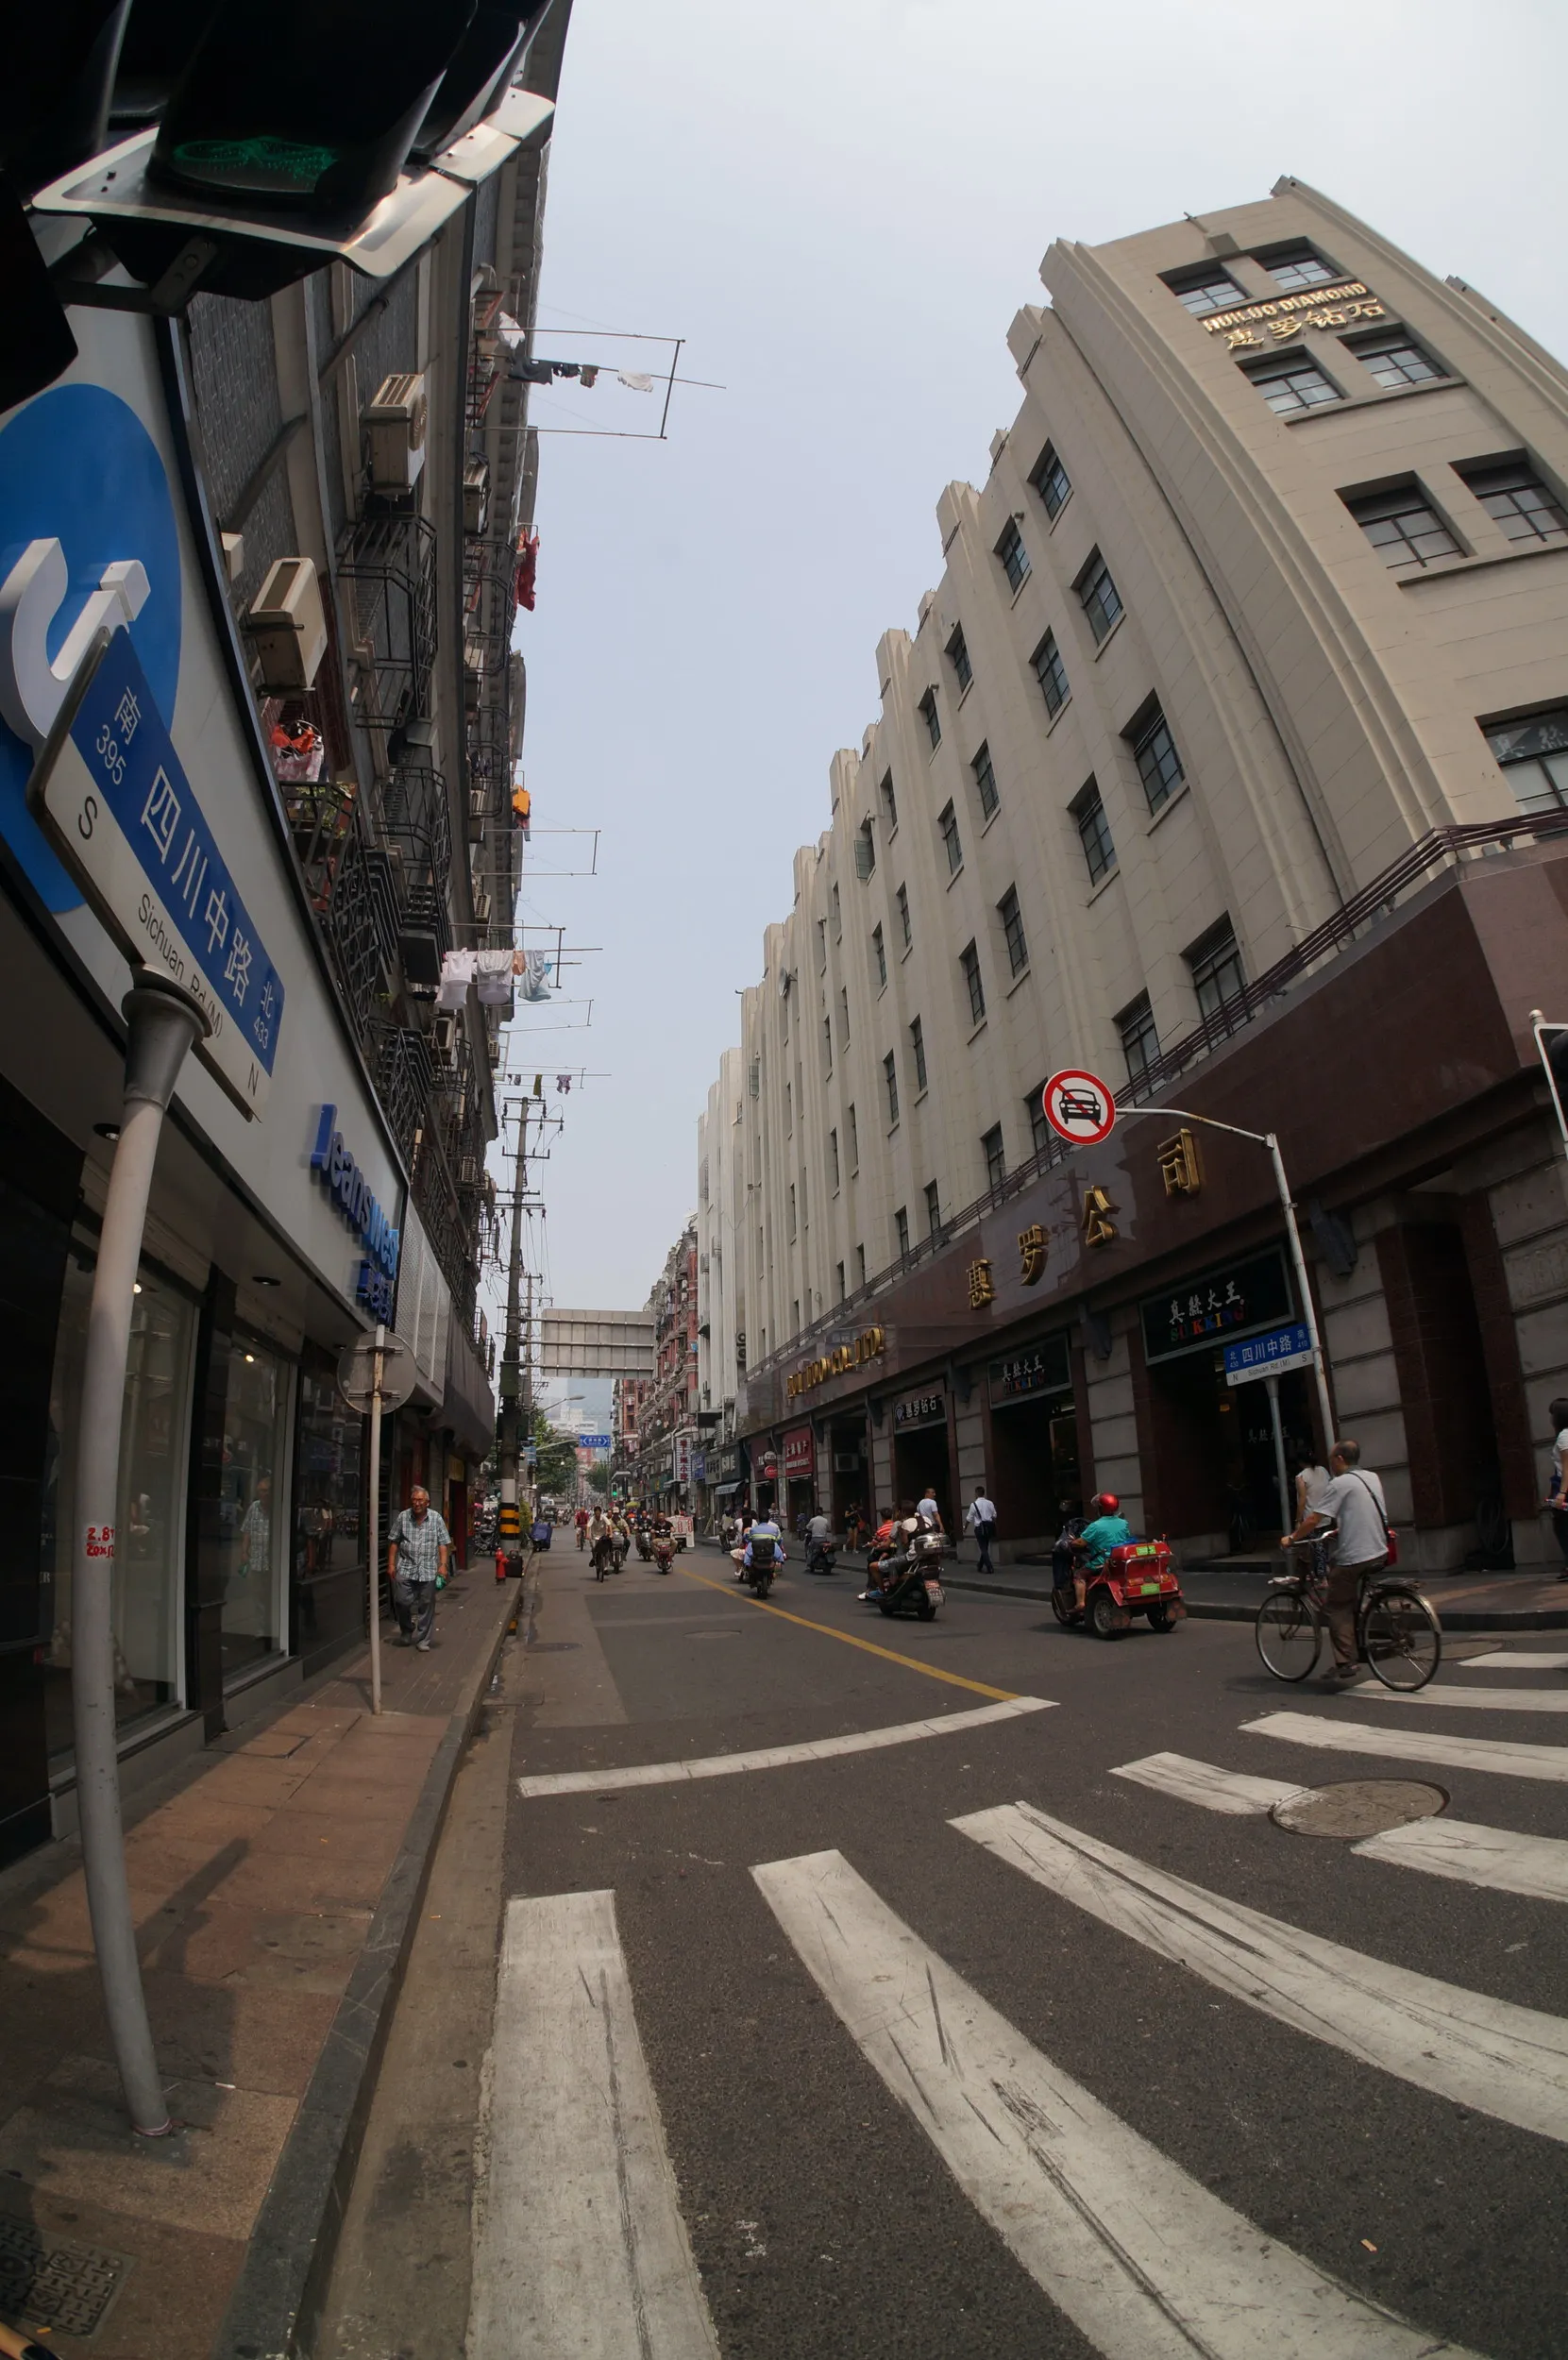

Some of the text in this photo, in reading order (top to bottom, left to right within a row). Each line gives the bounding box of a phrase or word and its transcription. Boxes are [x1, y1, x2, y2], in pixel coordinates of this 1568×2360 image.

[1203, 282, 1367, 333] HUILUO DIAMOND
[114, 686, 142, 746] 南
[96, 724, 126, 785] 395
[78, 796, 98, 840] S
[141, 765, 253, 1007] 四川中路
[138, 893, 185, 981] Sichuan
[260, 981, 274, 1019] 北
[253, 1016, 269, 1050] 433
[247, 1062, 260, 1096] N
[1241, 1334, 1292, 1363] 四川中路
[1301, 1354, 1307, 1363] S
[1232, 1374, 1239, 1383] N
